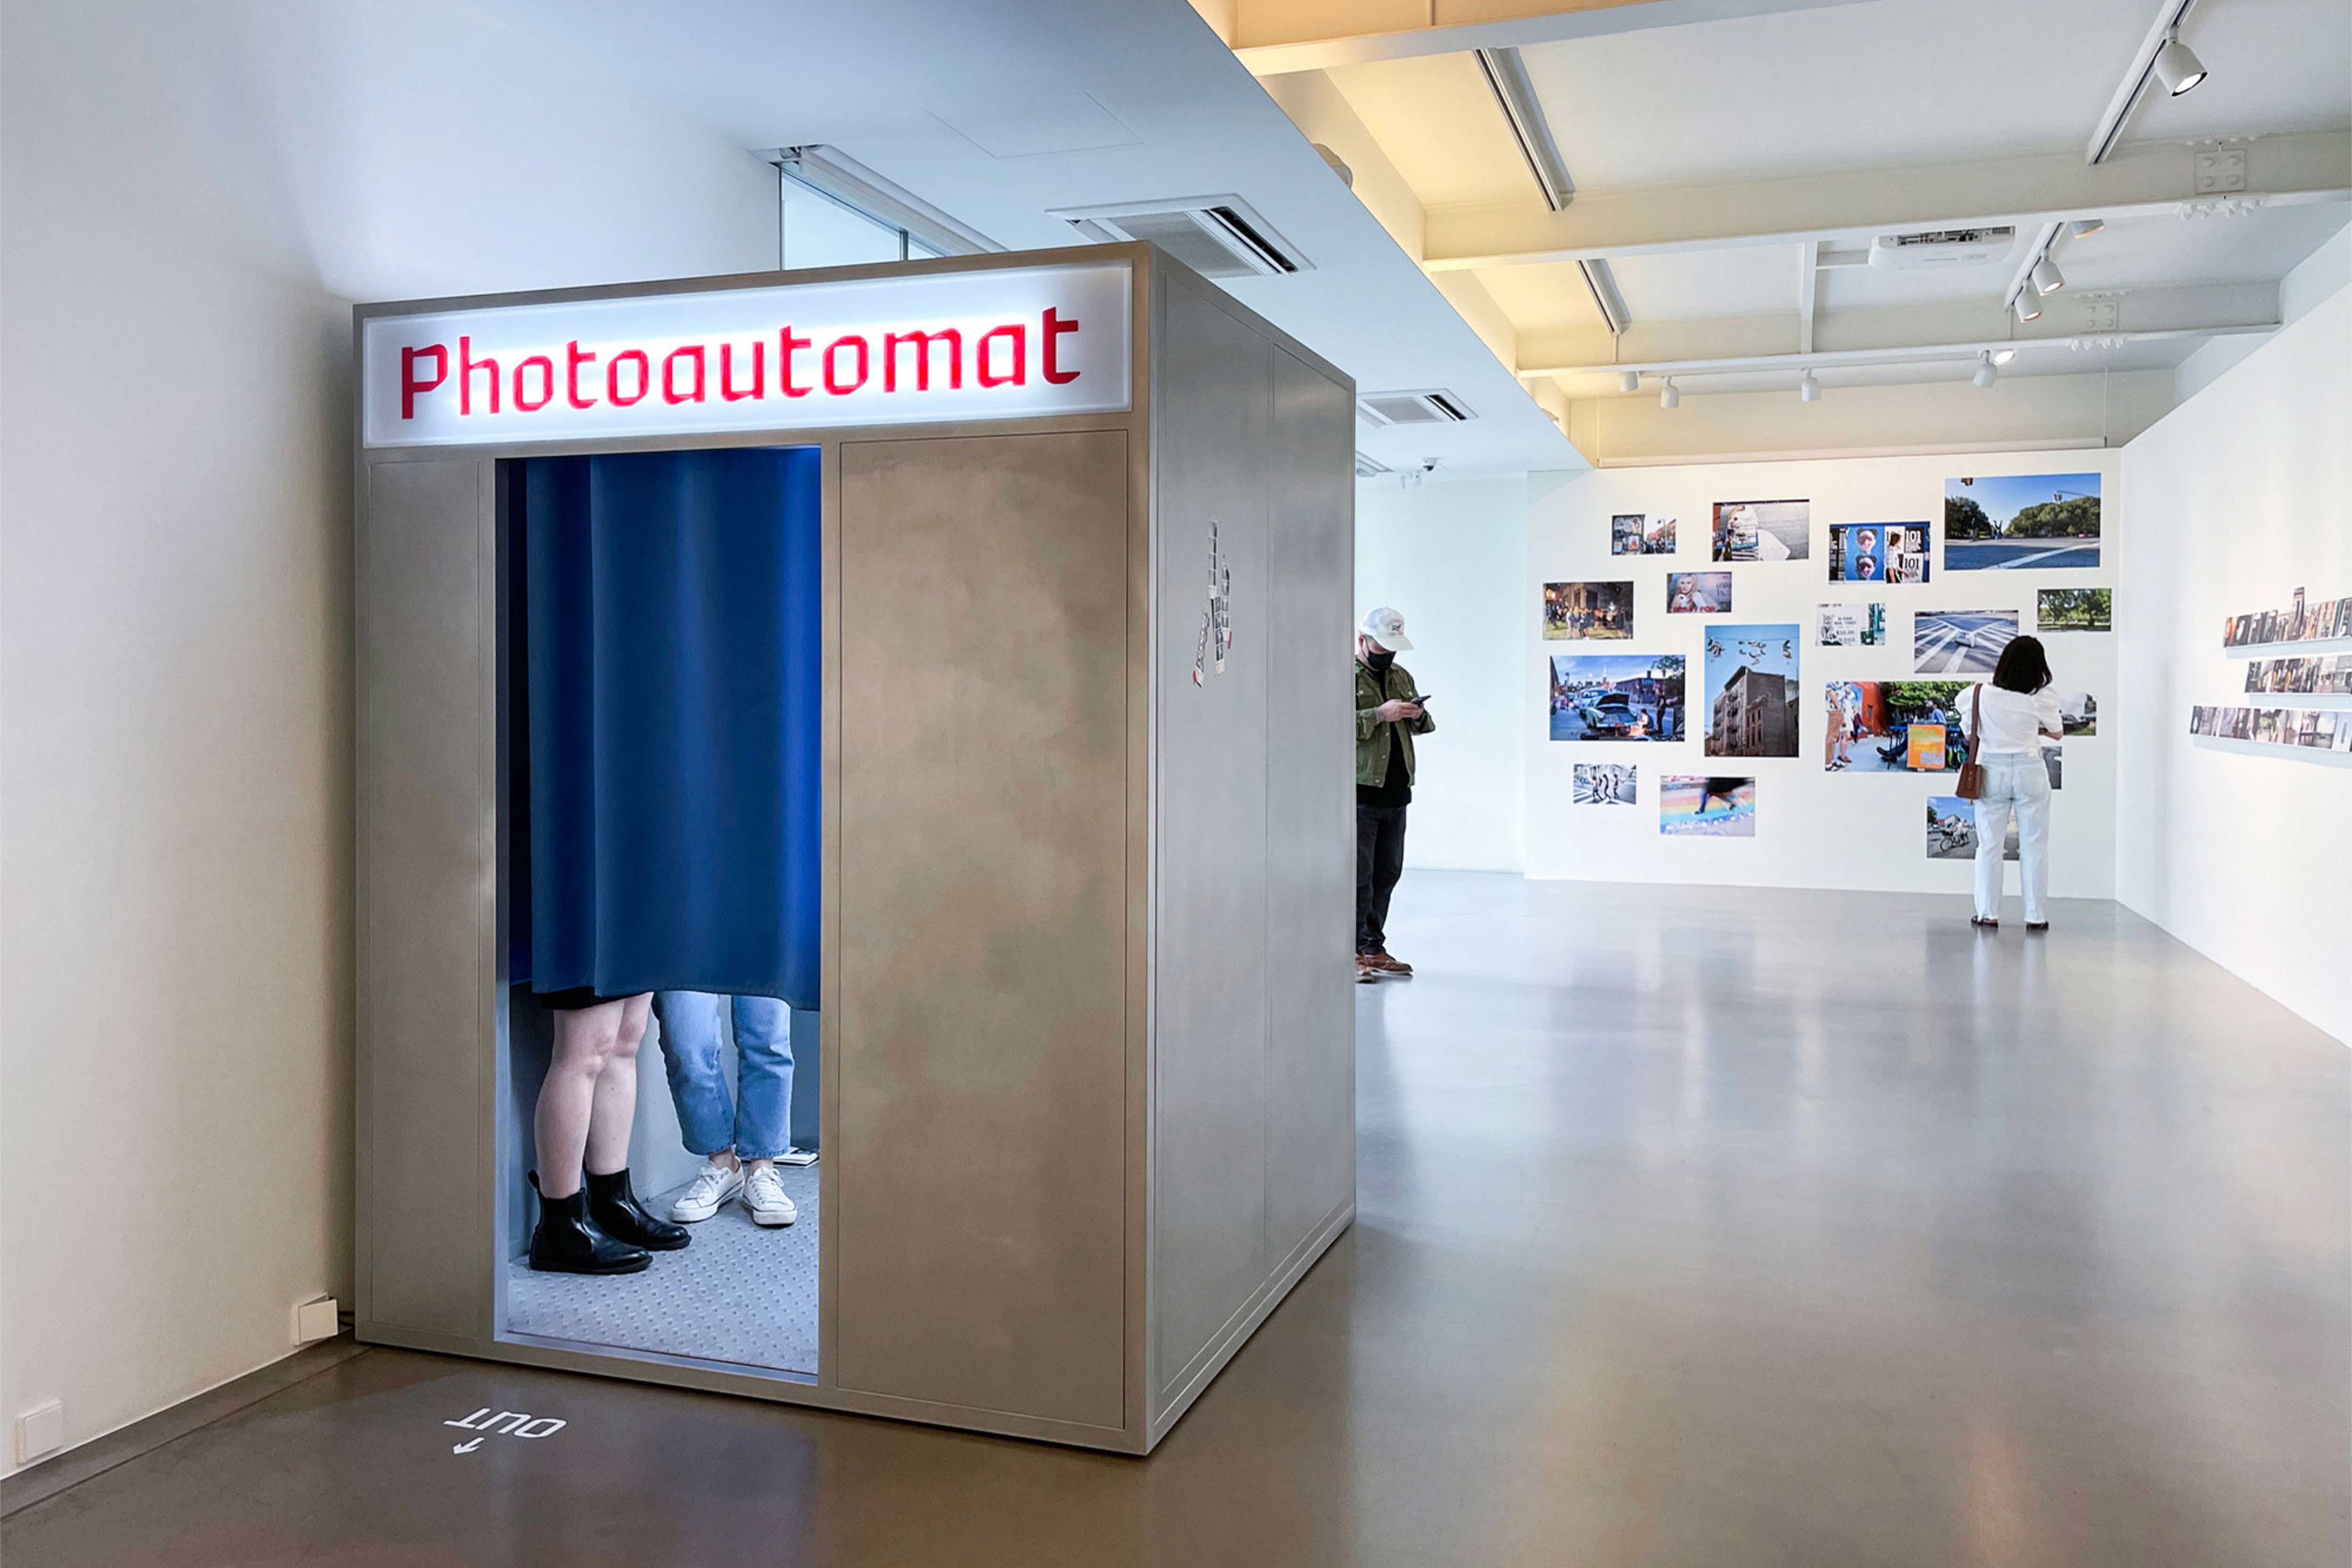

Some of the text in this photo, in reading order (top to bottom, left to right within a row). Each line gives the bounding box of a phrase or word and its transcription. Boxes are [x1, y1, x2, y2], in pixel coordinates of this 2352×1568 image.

[402, 307, 1080, 419] Photoautomat
[1906, 531, 1921, 542] 101
[1905, 558, 1919, 569] 101
[444, 1408, 568, 1438] OUT
